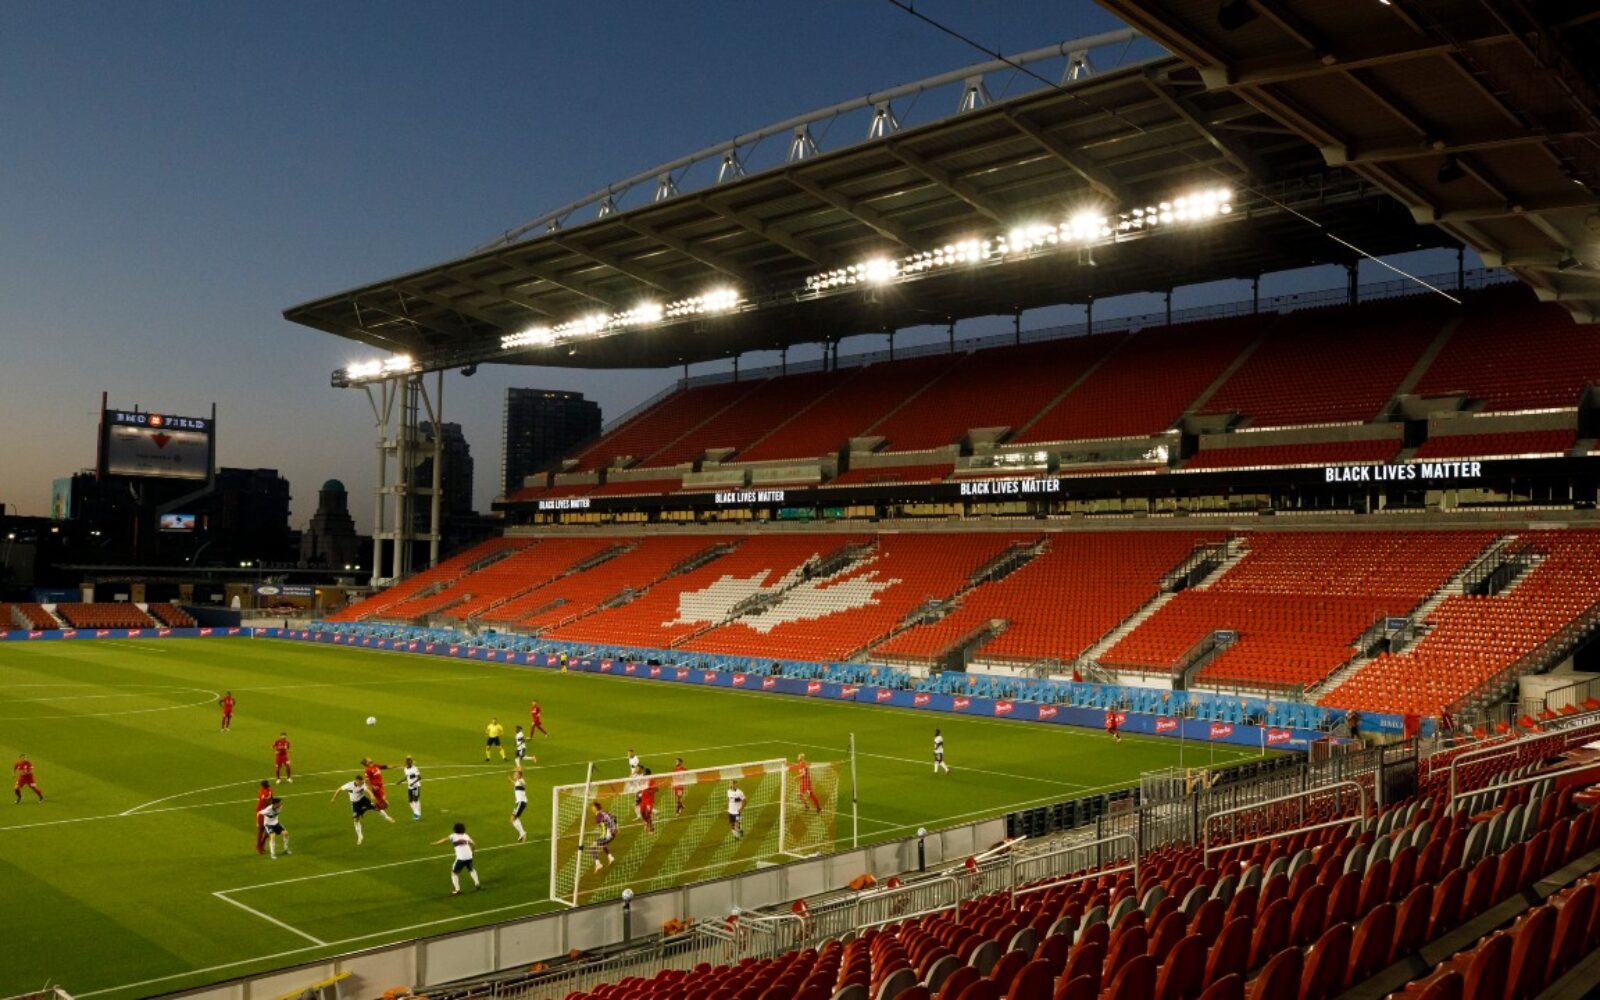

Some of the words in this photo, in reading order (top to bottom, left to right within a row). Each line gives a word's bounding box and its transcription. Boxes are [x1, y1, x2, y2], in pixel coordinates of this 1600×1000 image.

[117, 413, 146, 423] BMO
[165, 417, 206, 429] FIELD
[1325, 466, 1370, 482] BLACK
[1374, 464, 1416, 480] LIVES
[1421, 461, 1482, 478] MATTER
[961, 481, 989, 496] BLACK
[992, 480, 1019, 494] LIVES
[1021, 479, 1060, 493] MATTER
[715, 492, 736, 504] BLACK
[737, 491, 756, 503] LIVES
[757, 491, 785, 502] MATTER
[538, 500, 555, 510] BLACK
[1380, 719, 1404, 729] BMO
